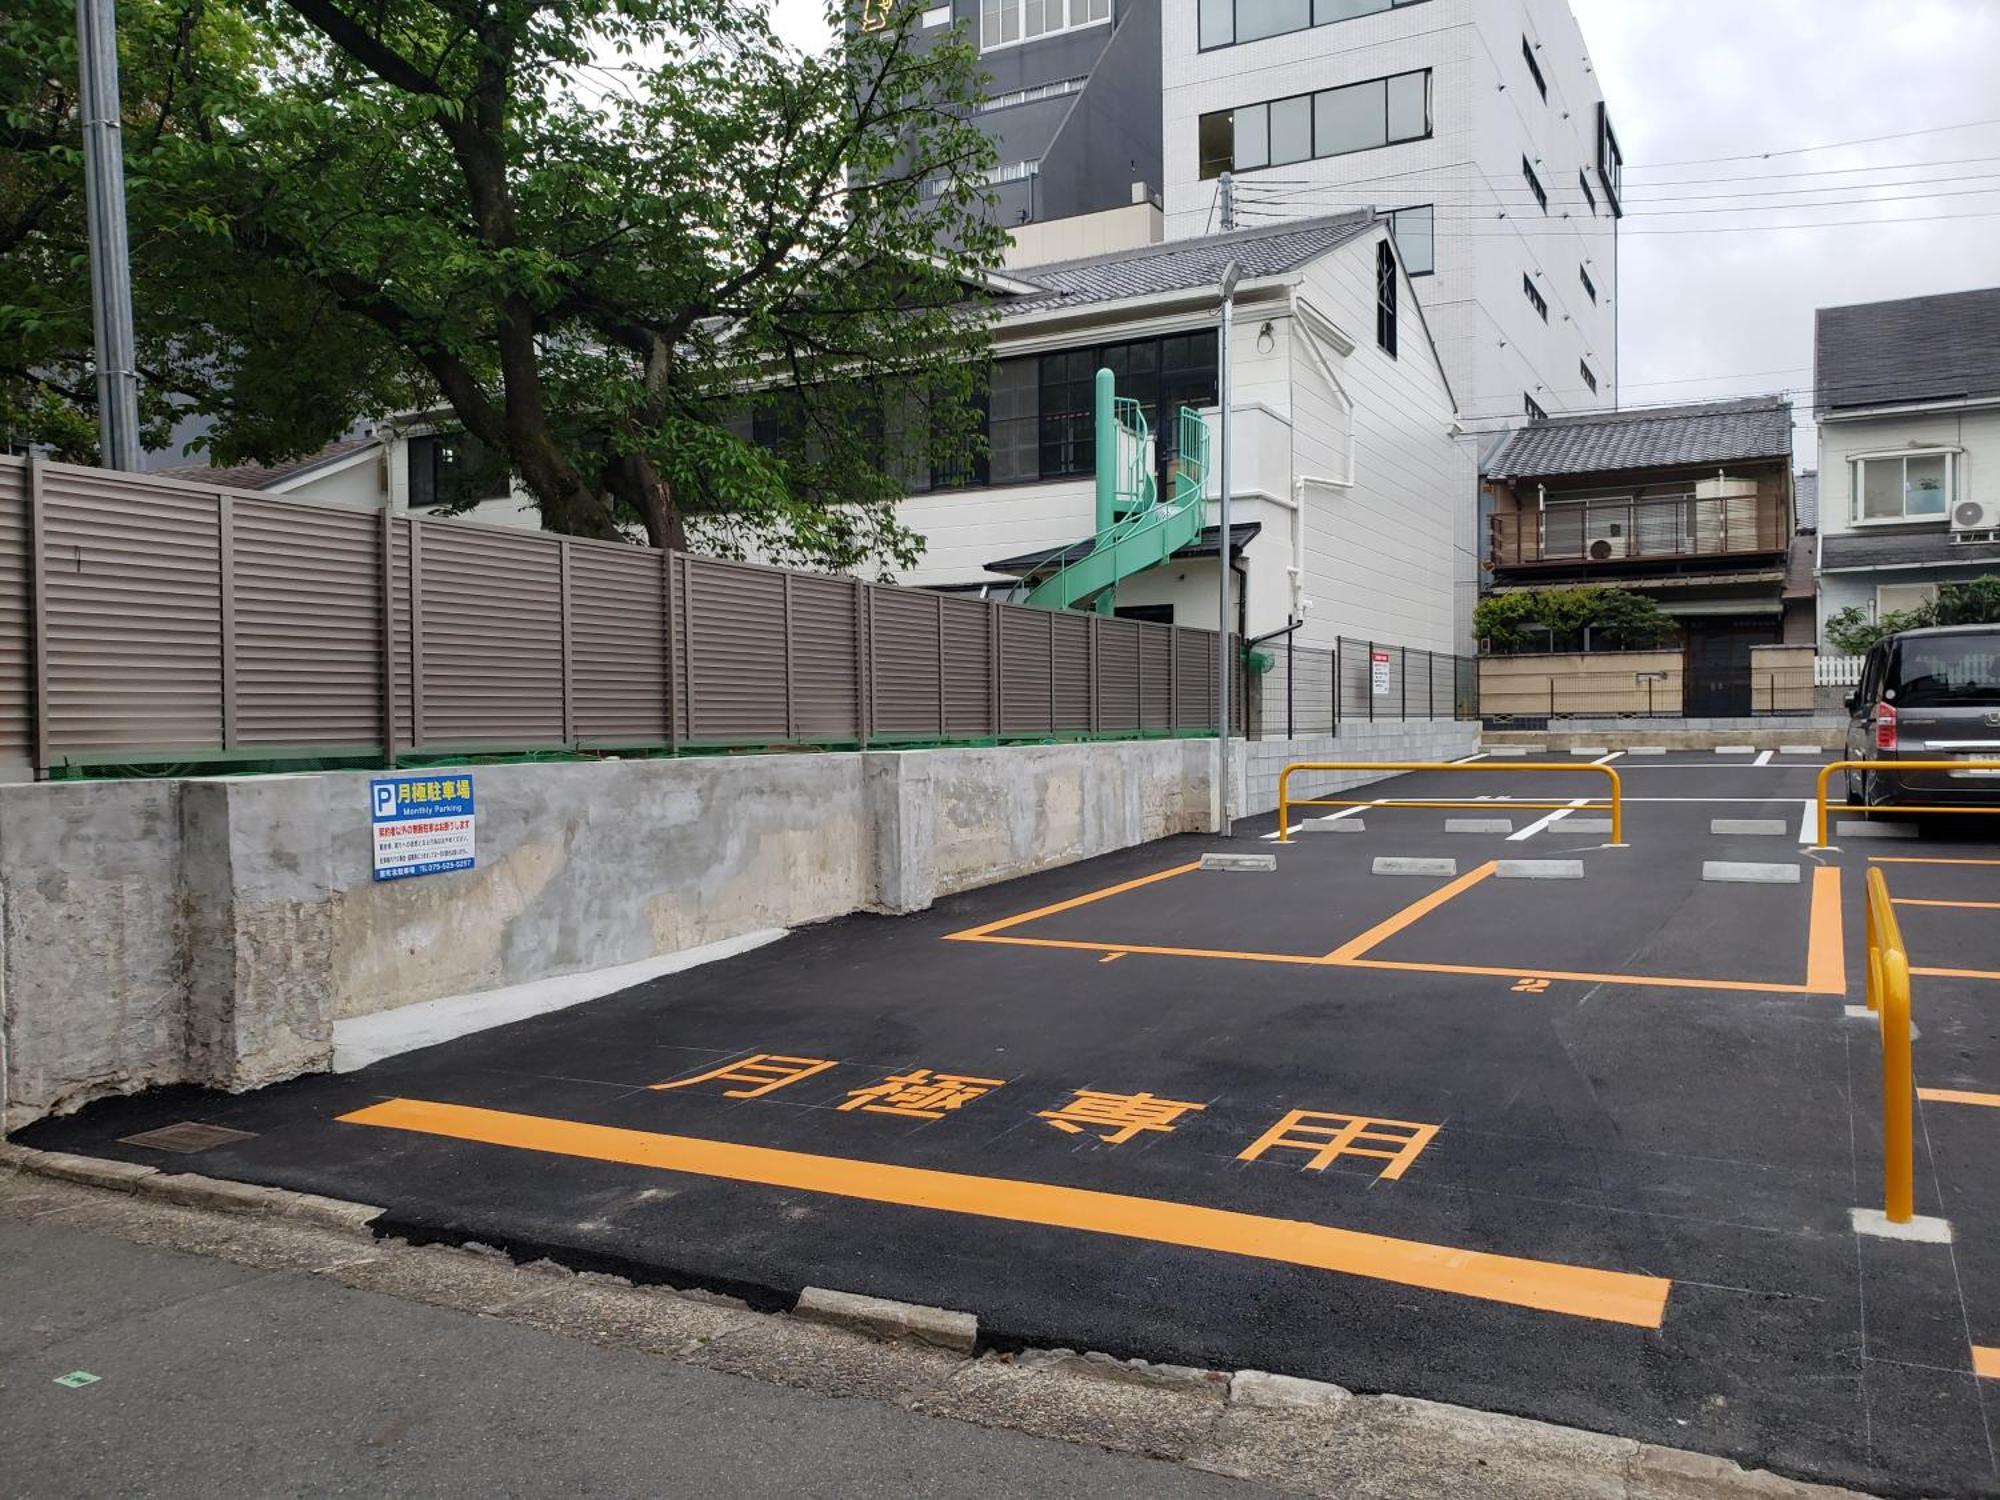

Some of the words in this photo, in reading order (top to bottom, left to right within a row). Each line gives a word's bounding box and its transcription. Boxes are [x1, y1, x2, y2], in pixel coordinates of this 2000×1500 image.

[377, 787, 392, 813] P
[397, 779, 471, 804] 月極駐車場
[403, 806, 432, 816] Monthly
[435, 804, 462, 814] Parking
[1098, 950, 1128, 963] 1
[1510, 977, 1553, 992] 2
[650, 1053, 1441, 1181] 月極専用
